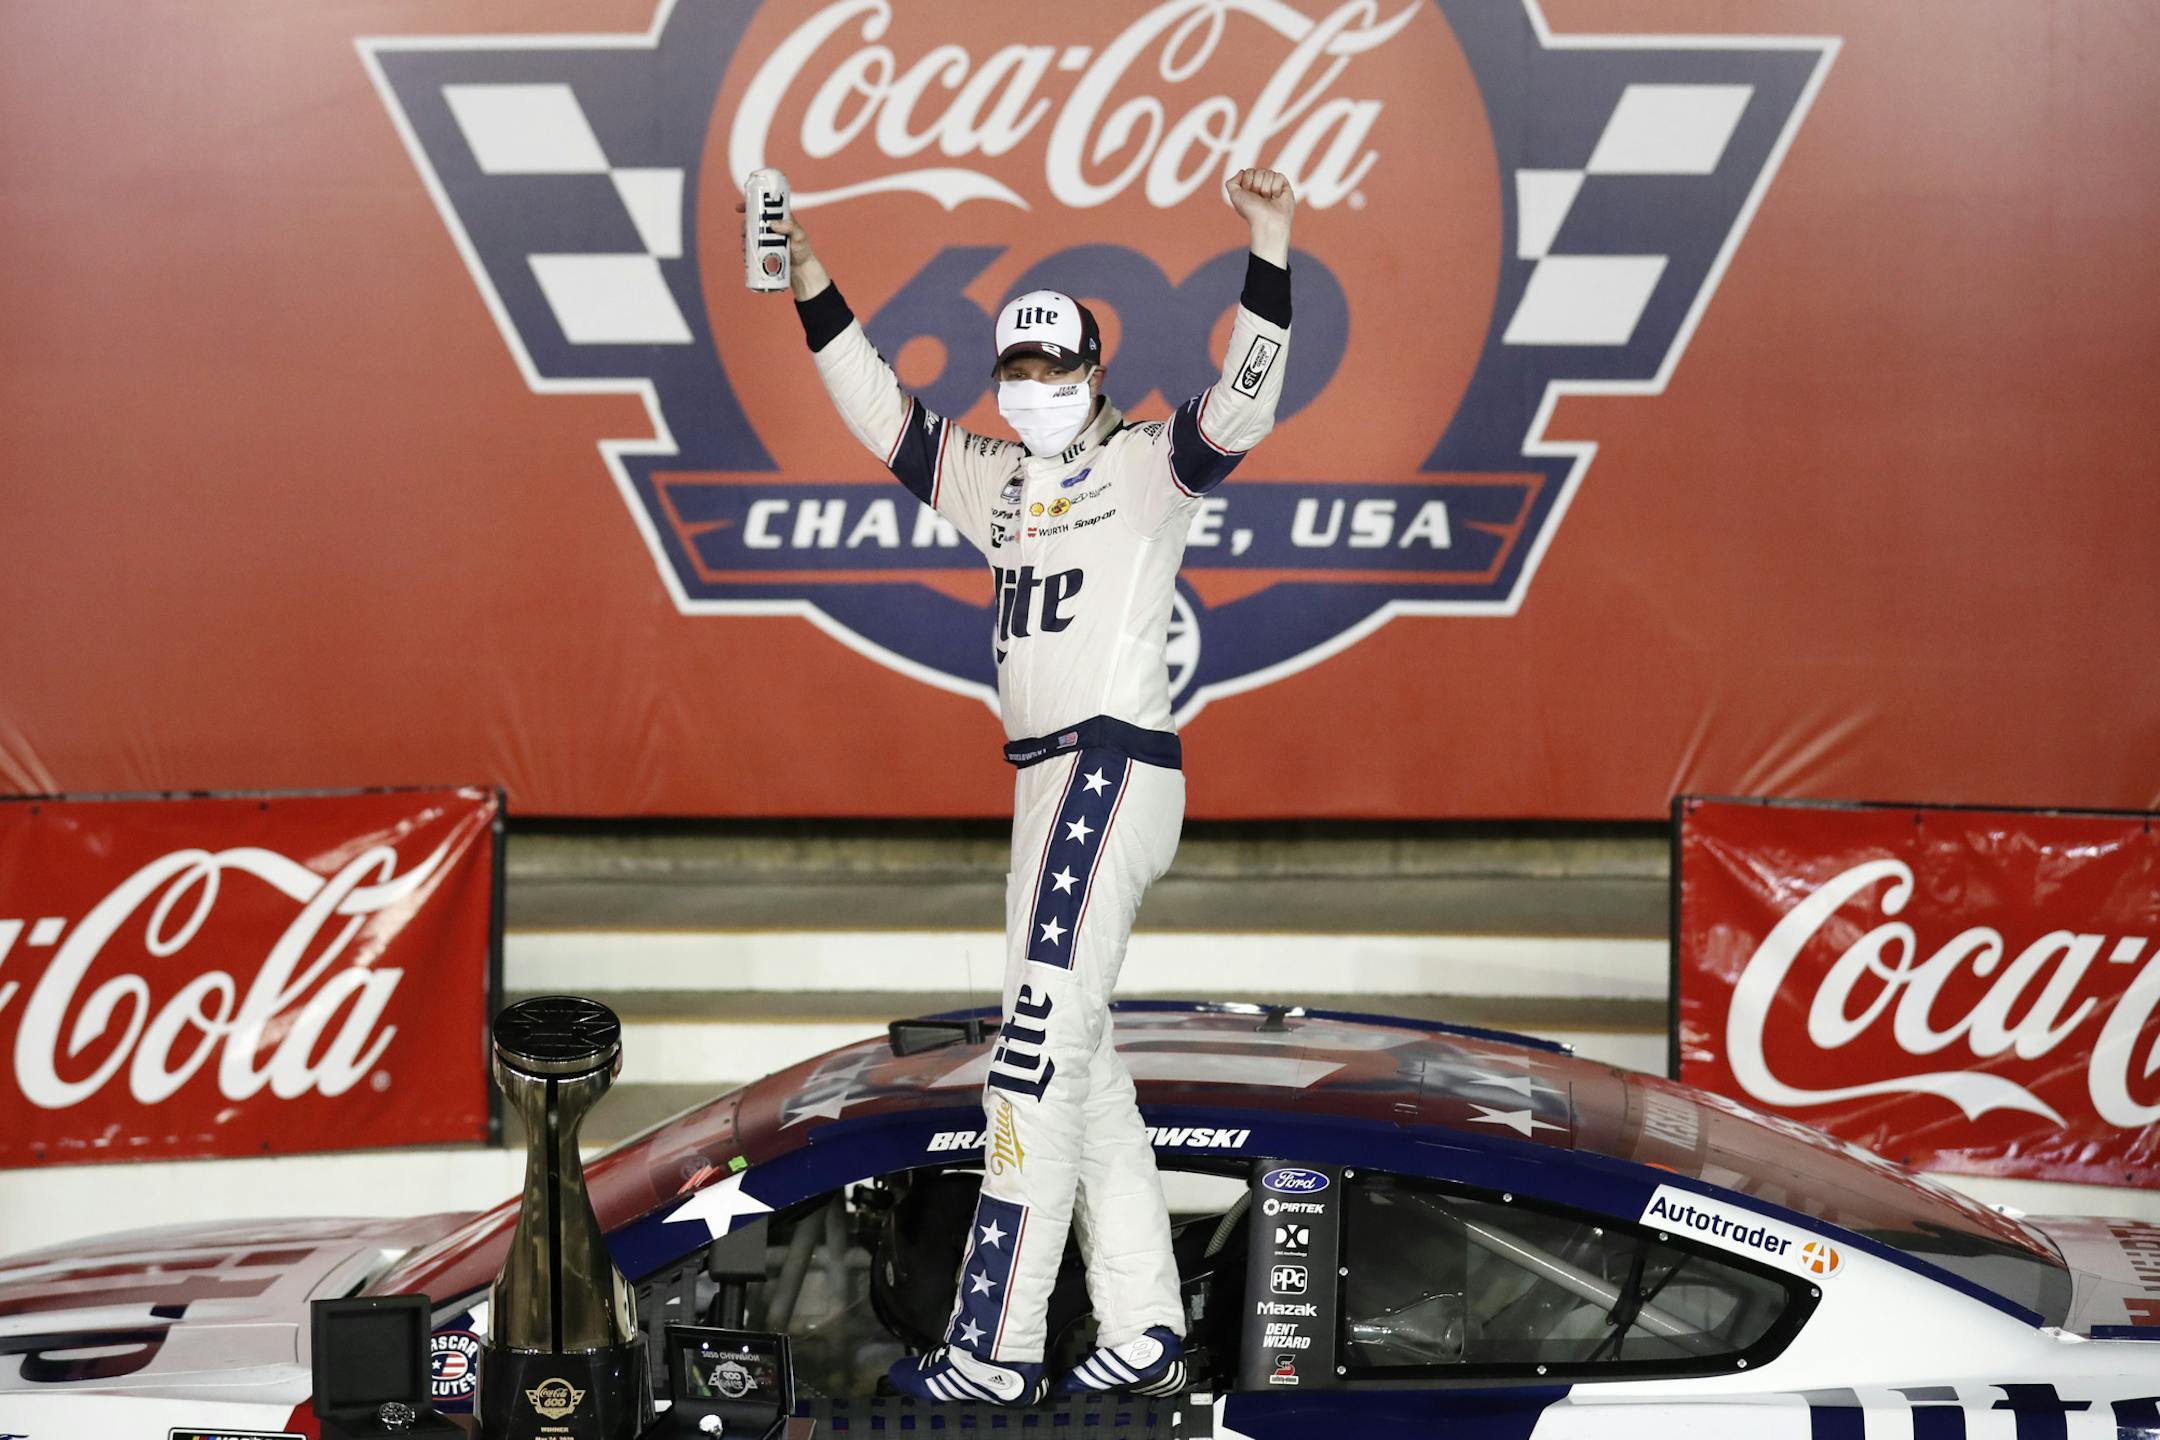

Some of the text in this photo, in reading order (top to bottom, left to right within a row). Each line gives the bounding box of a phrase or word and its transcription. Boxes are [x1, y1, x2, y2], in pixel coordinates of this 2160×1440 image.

[729, 0, 1422, 210] Coca-Cola
[1014, 306, 1058, 330] Lite
[1061, 441, 1087, 464] Lite
[1290, 499, 1452, 549] USA
[987, 984, 1056, 1103] Lite
[990, 1098, 1025, 1176] Mille
[1274, 1170, 1316, 1189] Ford
[1280, 1202, 1325, 1214] PIRTEK
[1649, 1196, 1792, 1256] Autotrader
[1273, 1268, 1305, 1290] PPG
[1256, 1301, 1318, 1317] Mazak
[1265, 1322, 1299, 1336] DENT
[431, 1335, 478, 1358] ASCAR
[1262, 1335, 1311, 1349] WIZARD
[432, 1372, 477, 1395] LUTES
[543, 1398, 567, 1407] 600
